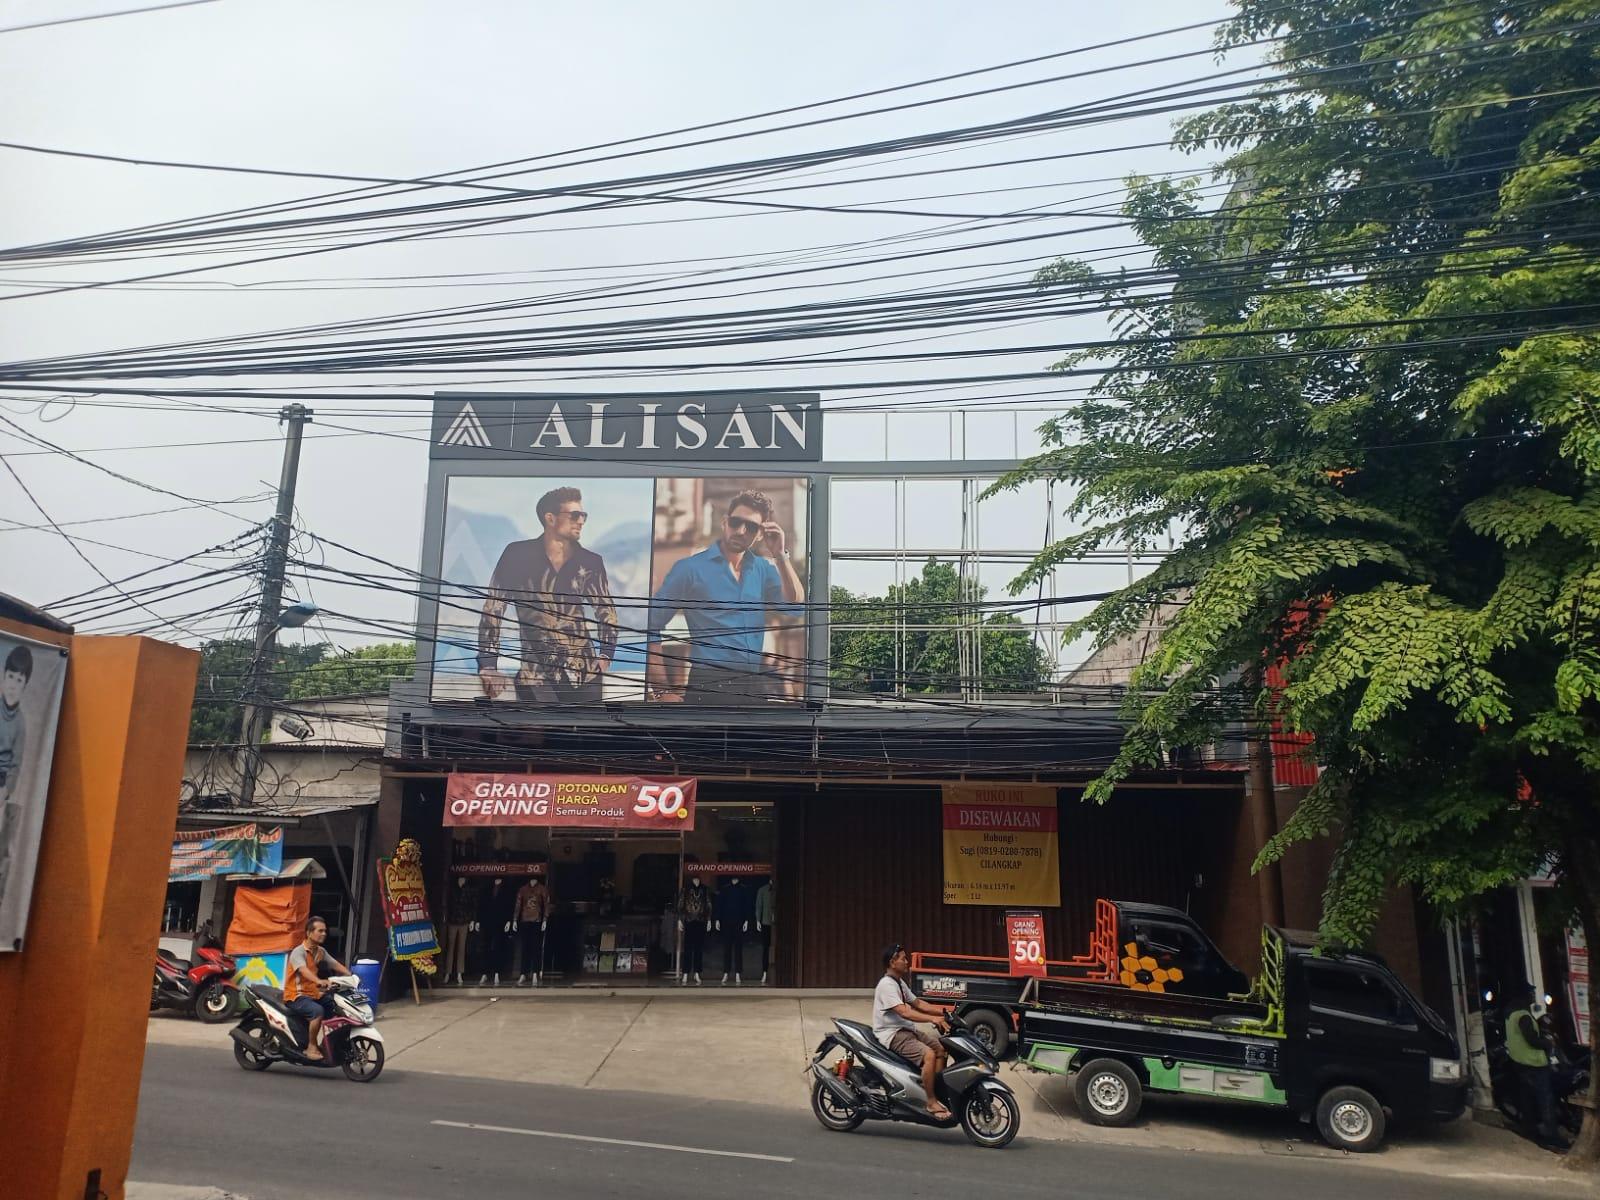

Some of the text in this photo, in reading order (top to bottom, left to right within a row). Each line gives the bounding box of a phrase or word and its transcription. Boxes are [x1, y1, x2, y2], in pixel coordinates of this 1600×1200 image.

[530, 401, 811, 450] ALISAN
[475, 782, 551, 798] GRAND
[558, 783, 627, 794] POTONGAN
[557, 795, 599, 805] HARGA
[633, 785, 684, 814] 50
[976, 789, 1006, 802] RUKO
[450, 799, 549, 816] OPENING
[555, 807, 625, 817] Semua Produk
[960, 809, 1040, 827] DISEWAKAN
[469, 864, 506, 873] OPENING
[687, 864, 716, 872] GRAND
[717, 864, 753, 872] OPENING
[980, 859, 1022, 870] CILANGKAP
[1012, 928, 1039, 936] OPENING
[1014, 940, 1041, 962] 50
